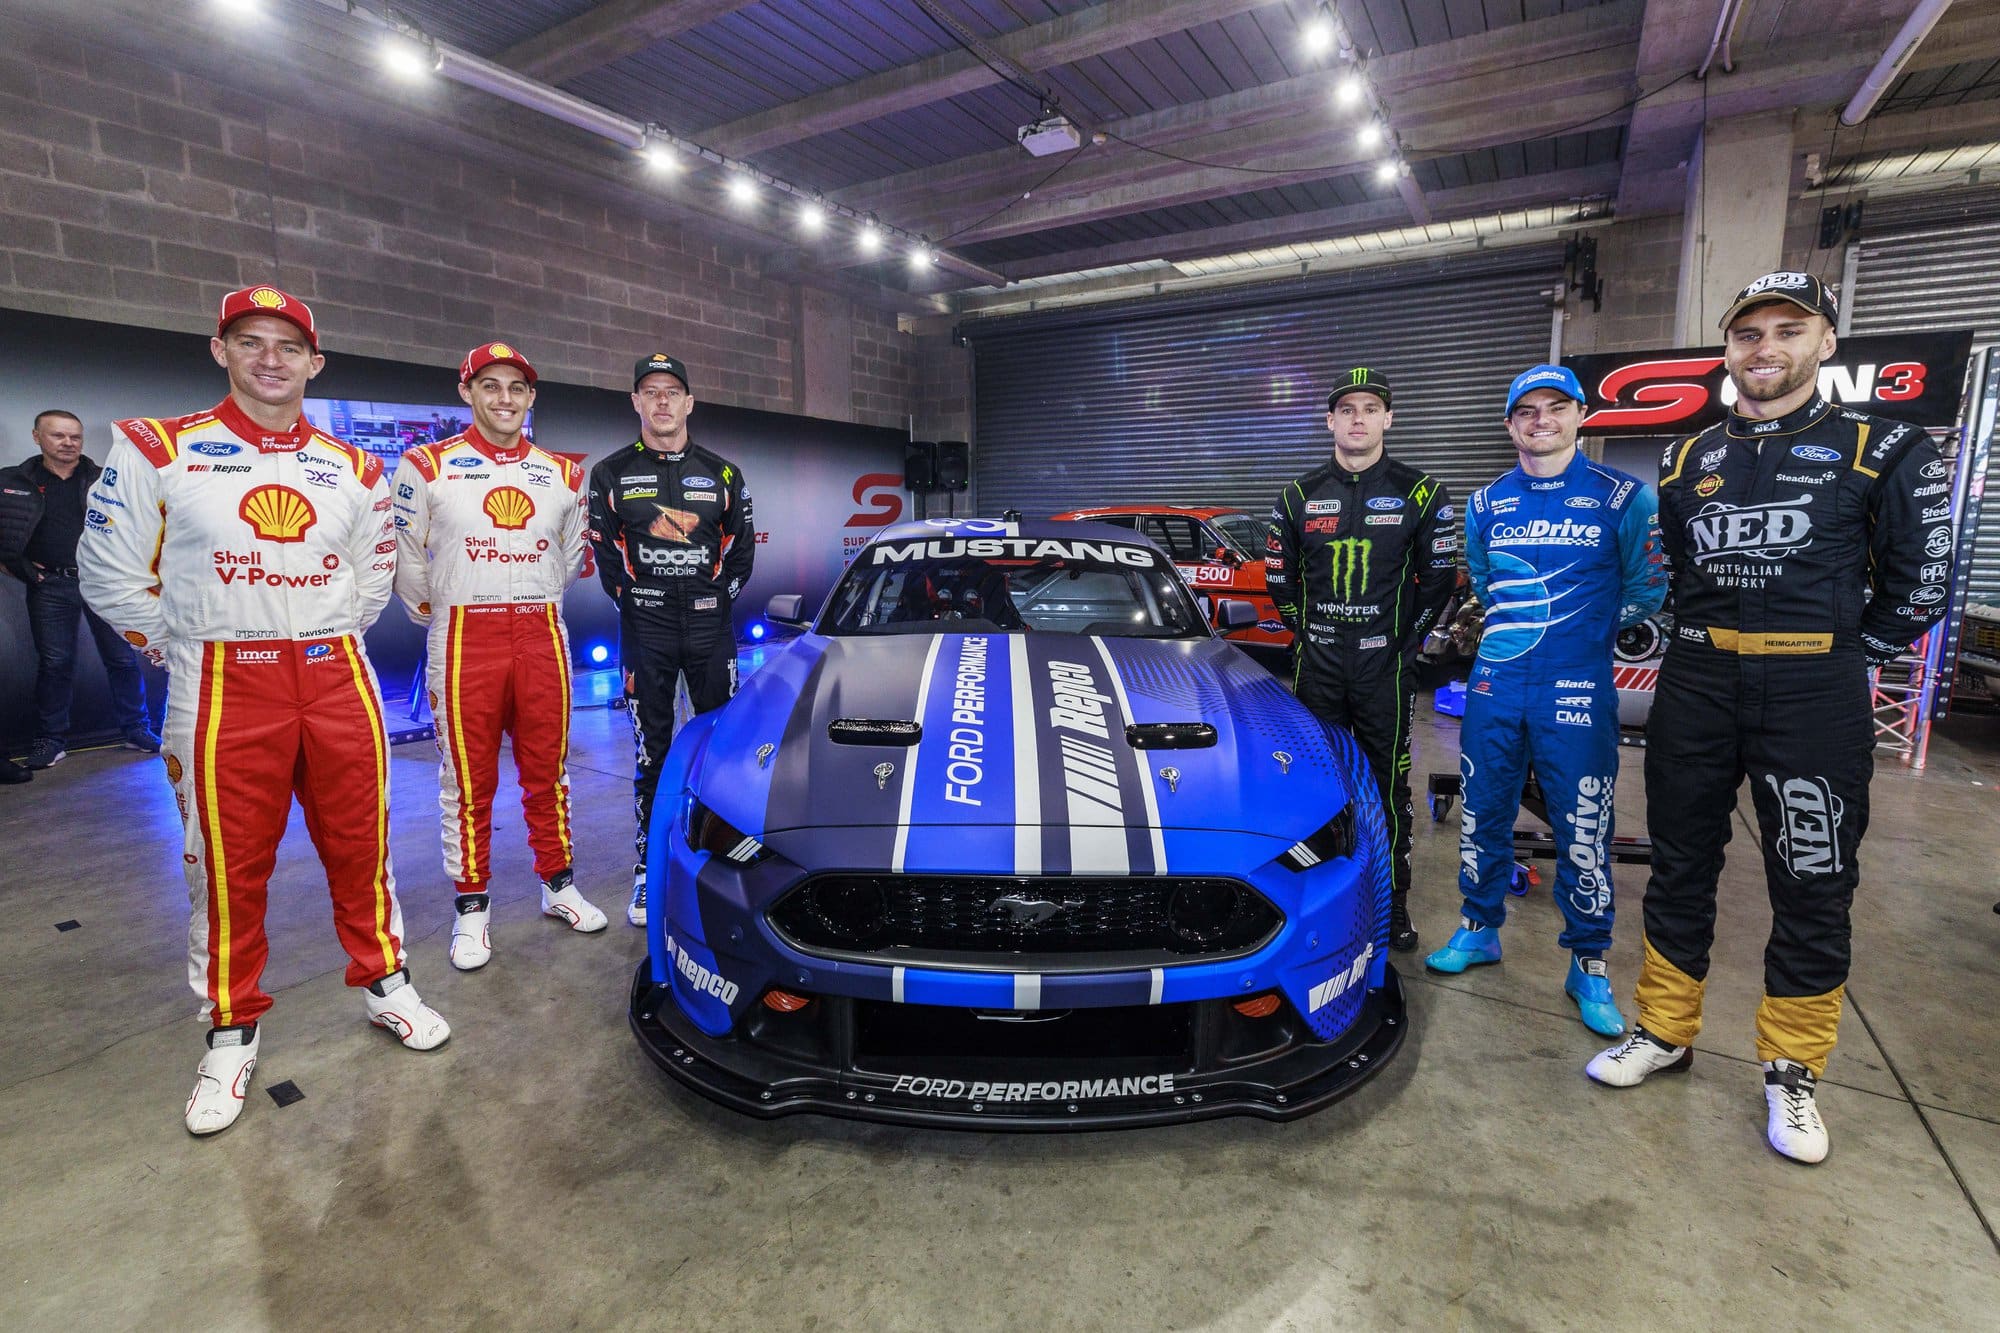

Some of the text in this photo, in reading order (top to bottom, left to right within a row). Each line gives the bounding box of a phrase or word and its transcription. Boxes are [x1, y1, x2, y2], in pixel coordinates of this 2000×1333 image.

[1745, 271, 1809, 297] NED
[1752, 420, 1781, 434] NED
[200, 442, 232, 455] Ford
[1872, 423, 1911, 460] HRX
[1798, 446, 1832, 461] Ford
[212, 464, 252, 474] Repco
[309, 456, 343, 471] PIRTEK
[305, 469, 338, 486] DXC
[464, 473, 490, 481] Repco
[1775, 473, 1823, 485] Steadfast
[1317, 503, 1338, 511] ENZED
[1305, 517, 1339, 532] CHICANE
[1374, 515, 1402, 524] Castrol
[1490, 518, 1602, 539] CoolDrive
[1690, 508, 1814, 554] NED
[465, 537, 496, 547] Shell
[213, 550, 262, 565] Shell
[466, 549, 542, 563] V-Power
[638, 543, 710, 565] boost
[872, 539, 1155, 568] MUSTANG
[215, 566, 333, 588] V-Power
[653, 566, 697, 576] mobile
[1199, 567, 1230, 581] 500
[1706, 563, 1783, 577] AUSTRALIAN
[1716, 577, 1767, 589] WHISKY
[515, 604, 546, 614] GROVE
[1316, 602, 1381, 617] MONSTER
[1896, 606, 1947, 616] GROVE
[299, 627, 335, 638] DAVISON
[1309, 622, 1336, 634] WATERS
[1680, 626, 1707, 639] HRX
[1764, 639, 1823, 648] HEIMGARTNER
[236, 648, 281, 660] imar
[306, 654, 336, 665] Doric
[951, 636, 989, 726] PERFORMANCE
[1554, 679, 1597, 689] Slade
[1048, 660, 1113, 740] Repco
[1556, 710, 1592, 725] CMA
[945, 727, 984, 807] FORD
[1782, 776, 1834, 875] NED
[676, 945, 740, 1006] Repco
[892, 1073, 1175, 1102] FORD PERFORMANCE
